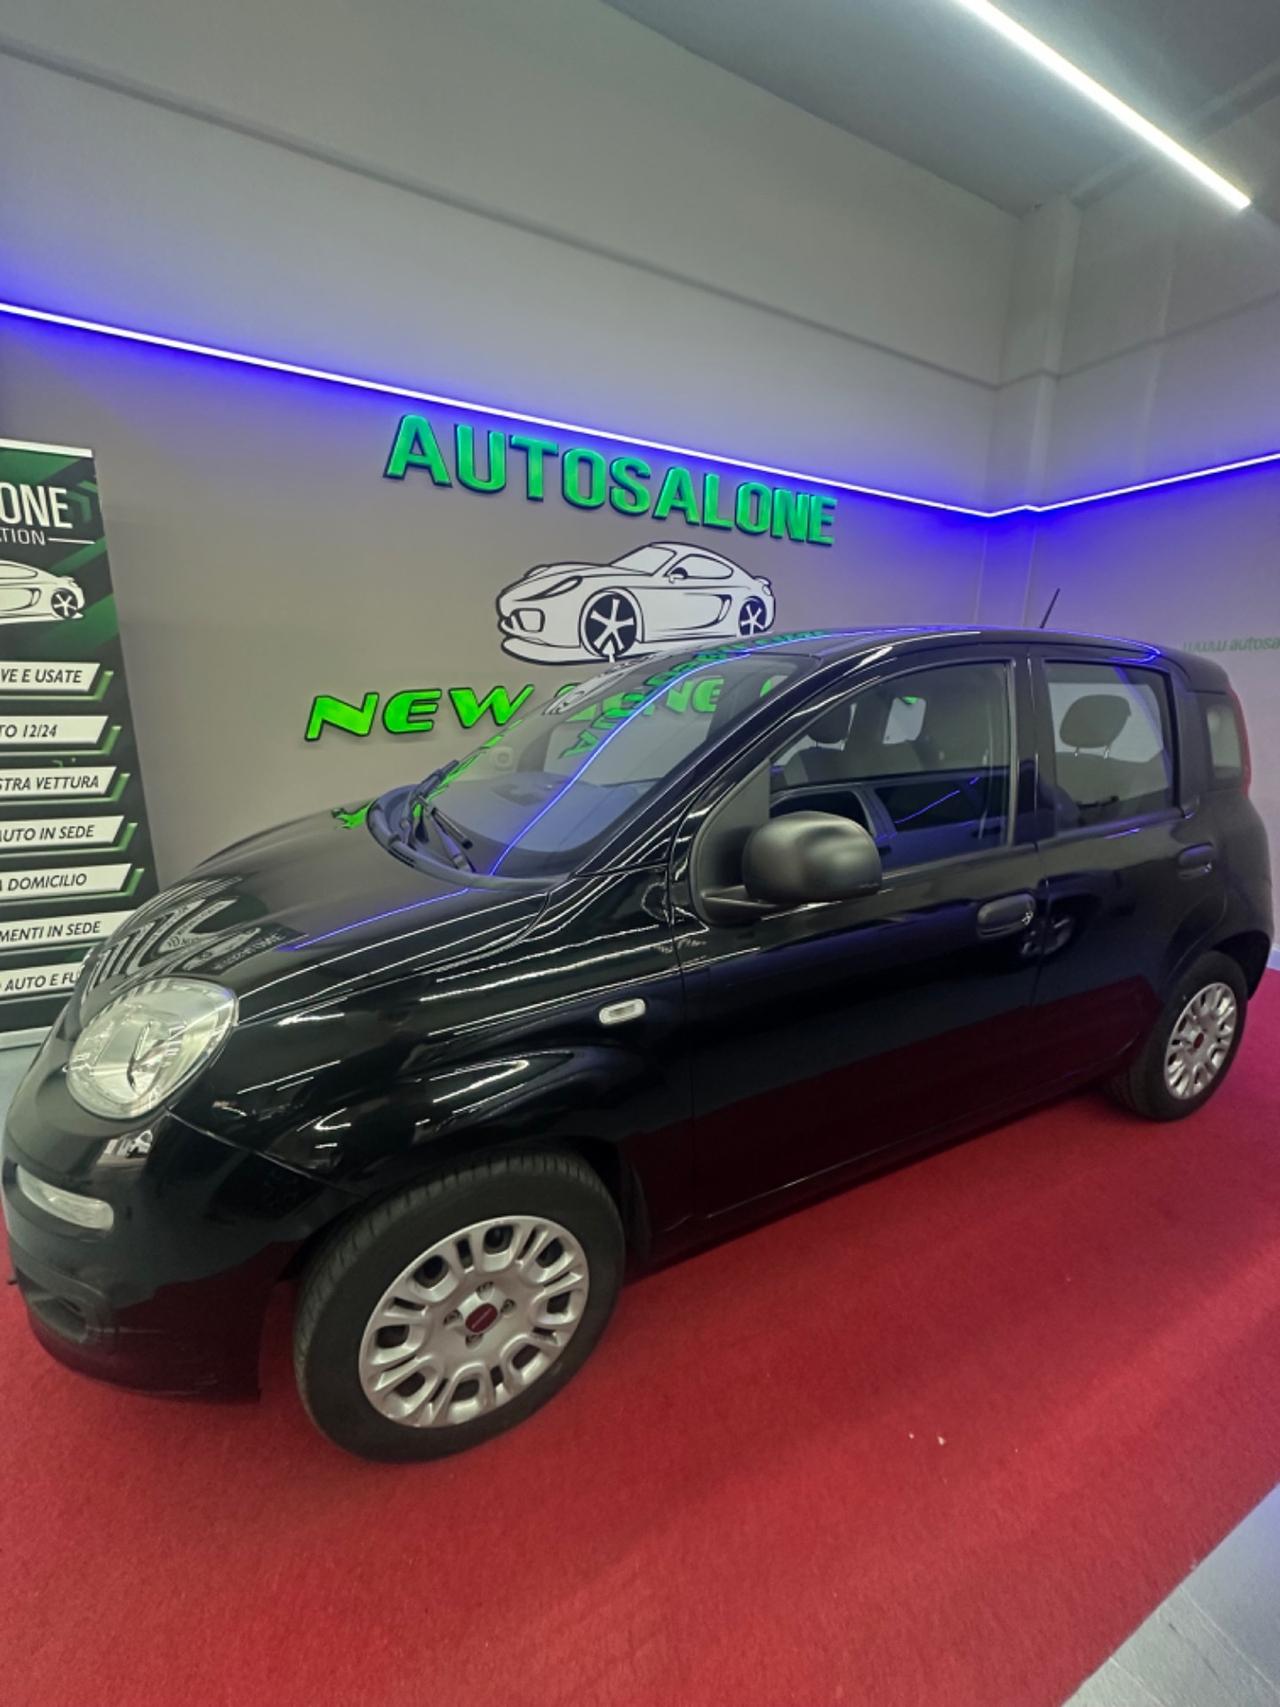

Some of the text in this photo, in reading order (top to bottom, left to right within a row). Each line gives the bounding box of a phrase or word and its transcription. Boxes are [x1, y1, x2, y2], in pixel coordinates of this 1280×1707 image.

[383, 414, 838, 545] AUTOSALONE
[0, 482, 73, 529] ONE
[0, 528, 46, 546] TION
[21, 669, 31, 683] E
[35, 669, 82, 683] USATE
[304, 684, 535, 742] NEW
[22, 724, 58, 738] 12/24
[36, 775, 99, 790] VETTURA
[0, 824, 95, 842] UTO IN SEDE
[8, 873, 87, 891] DOMICILIO
[47, 924, 63, 938] IN
[65, 921, 101, 936] SEDE
[4, 975, 46, 992] AUTO
[49, 973, 59, 986] E
